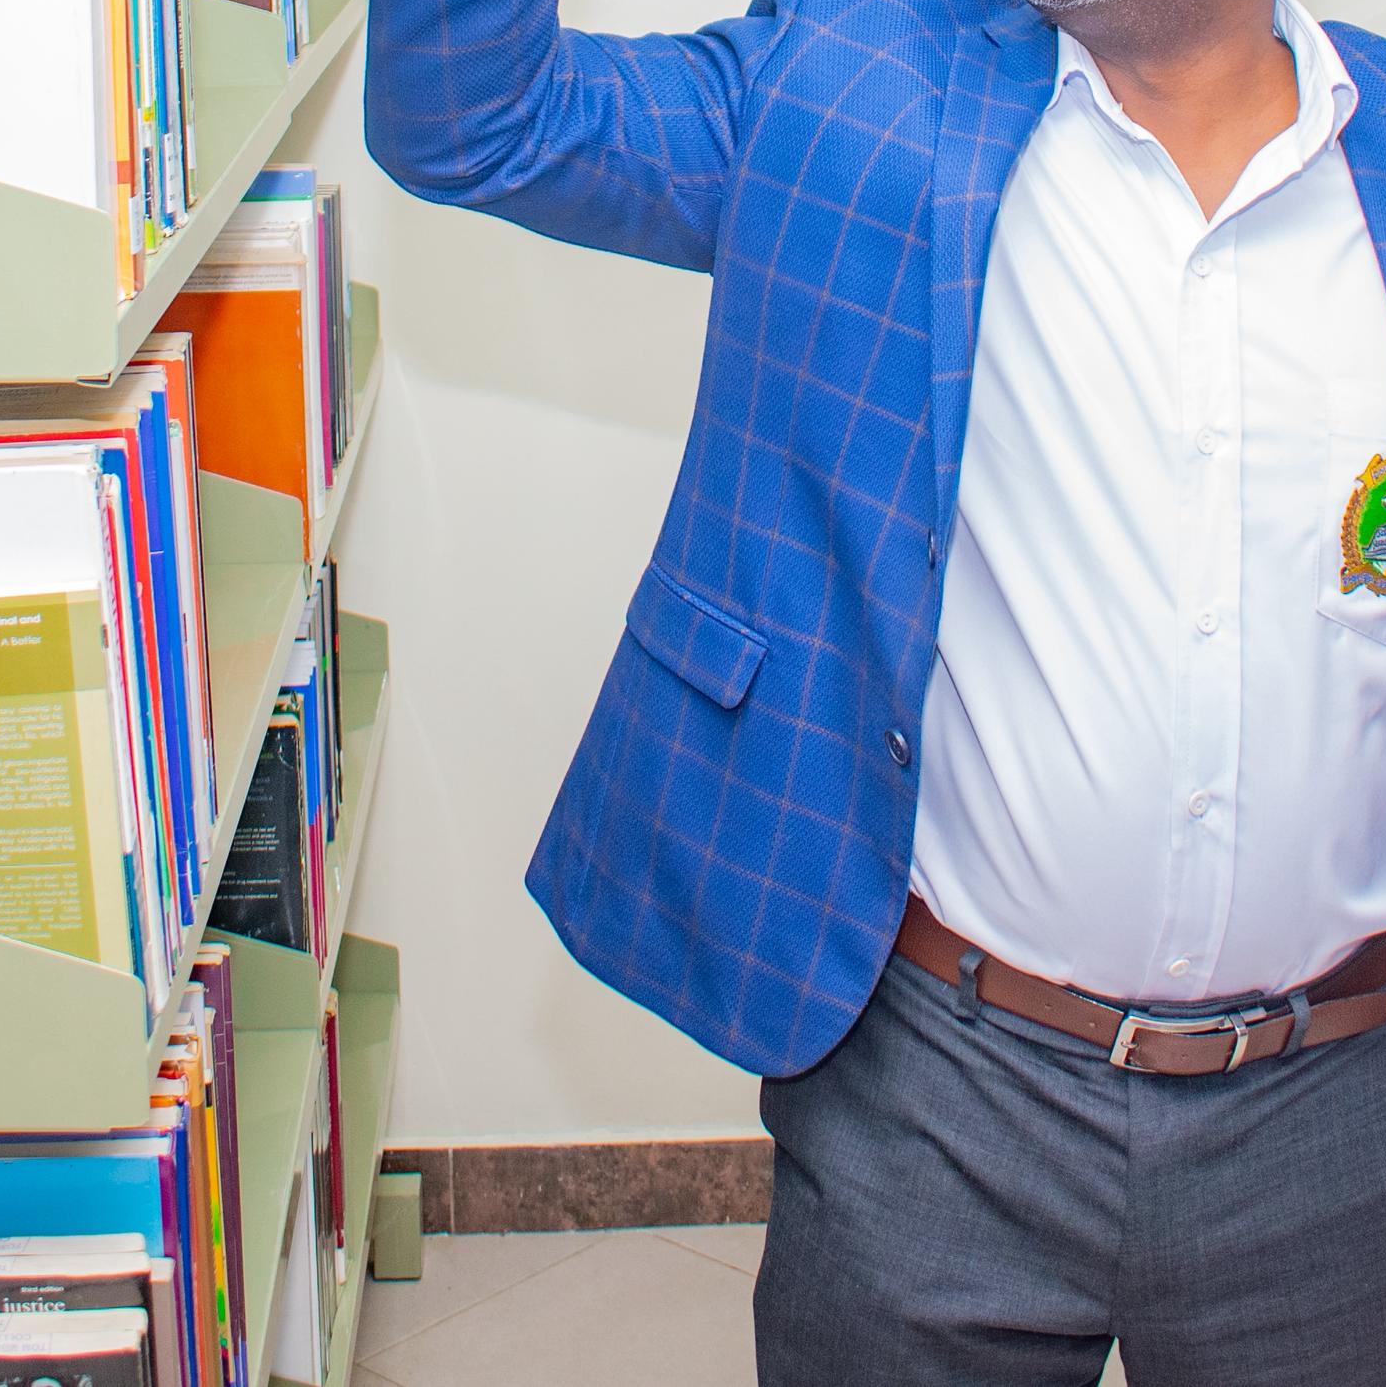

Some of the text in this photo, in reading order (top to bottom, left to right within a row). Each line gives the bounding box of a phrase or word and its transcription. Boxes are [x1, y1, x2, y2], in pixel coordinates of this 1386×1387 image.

[19, 613, 41, 624] and
[0, 637, 9, 647] A
[11, 635, 42, 646] Better
[20, 1285, 38, 1293] third
[2, 1296, 66, 1313] justice
